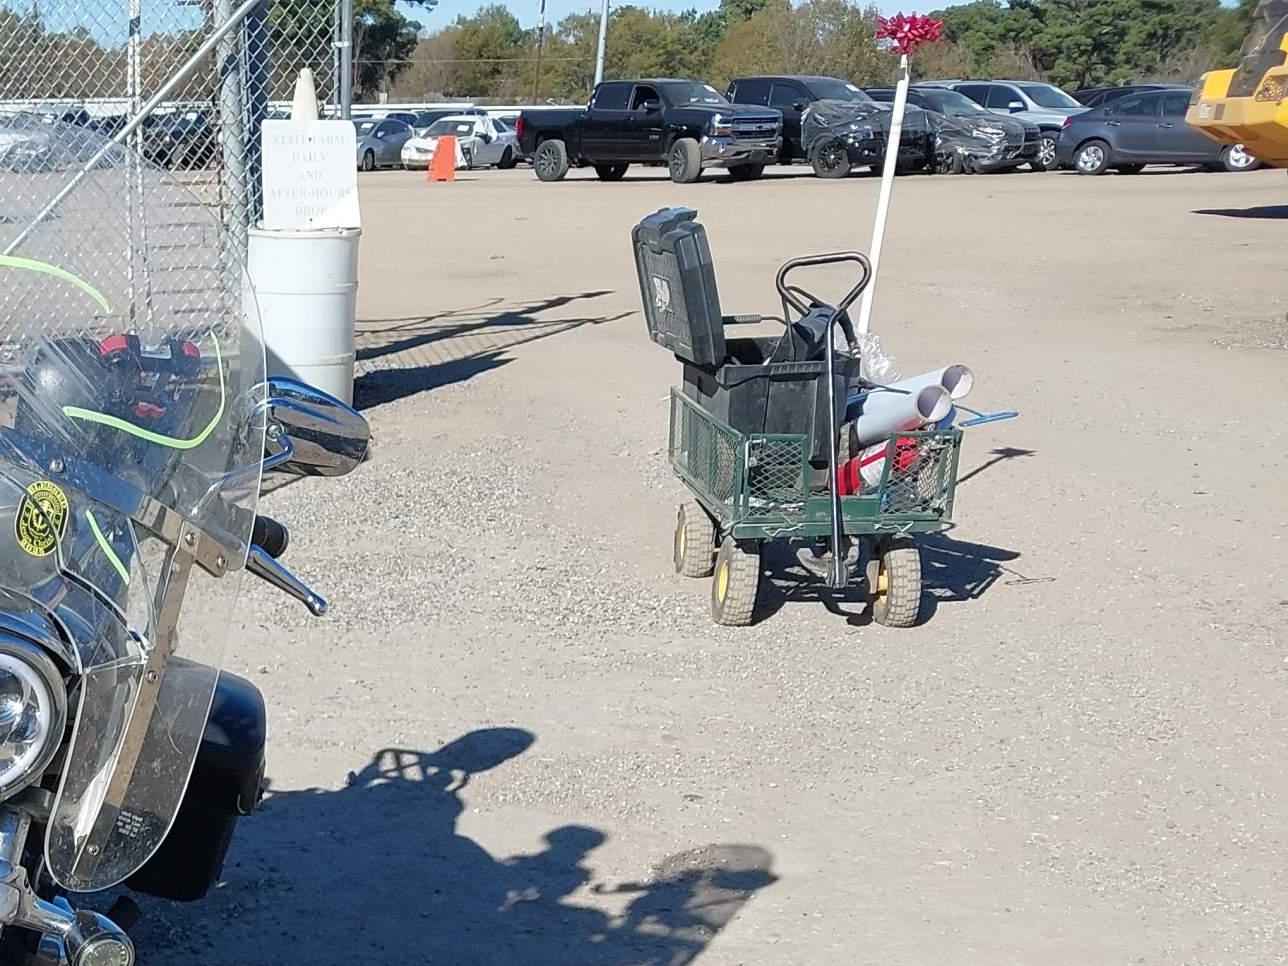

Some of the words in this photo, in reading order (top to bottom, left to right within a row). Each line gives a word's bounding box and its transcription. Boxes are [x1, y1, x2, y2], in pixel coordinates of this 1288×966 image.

[291, 151, 328, 163] DAILY
[298, 169, 323, 181] AND
[295, 205, 328, 217] DROP
